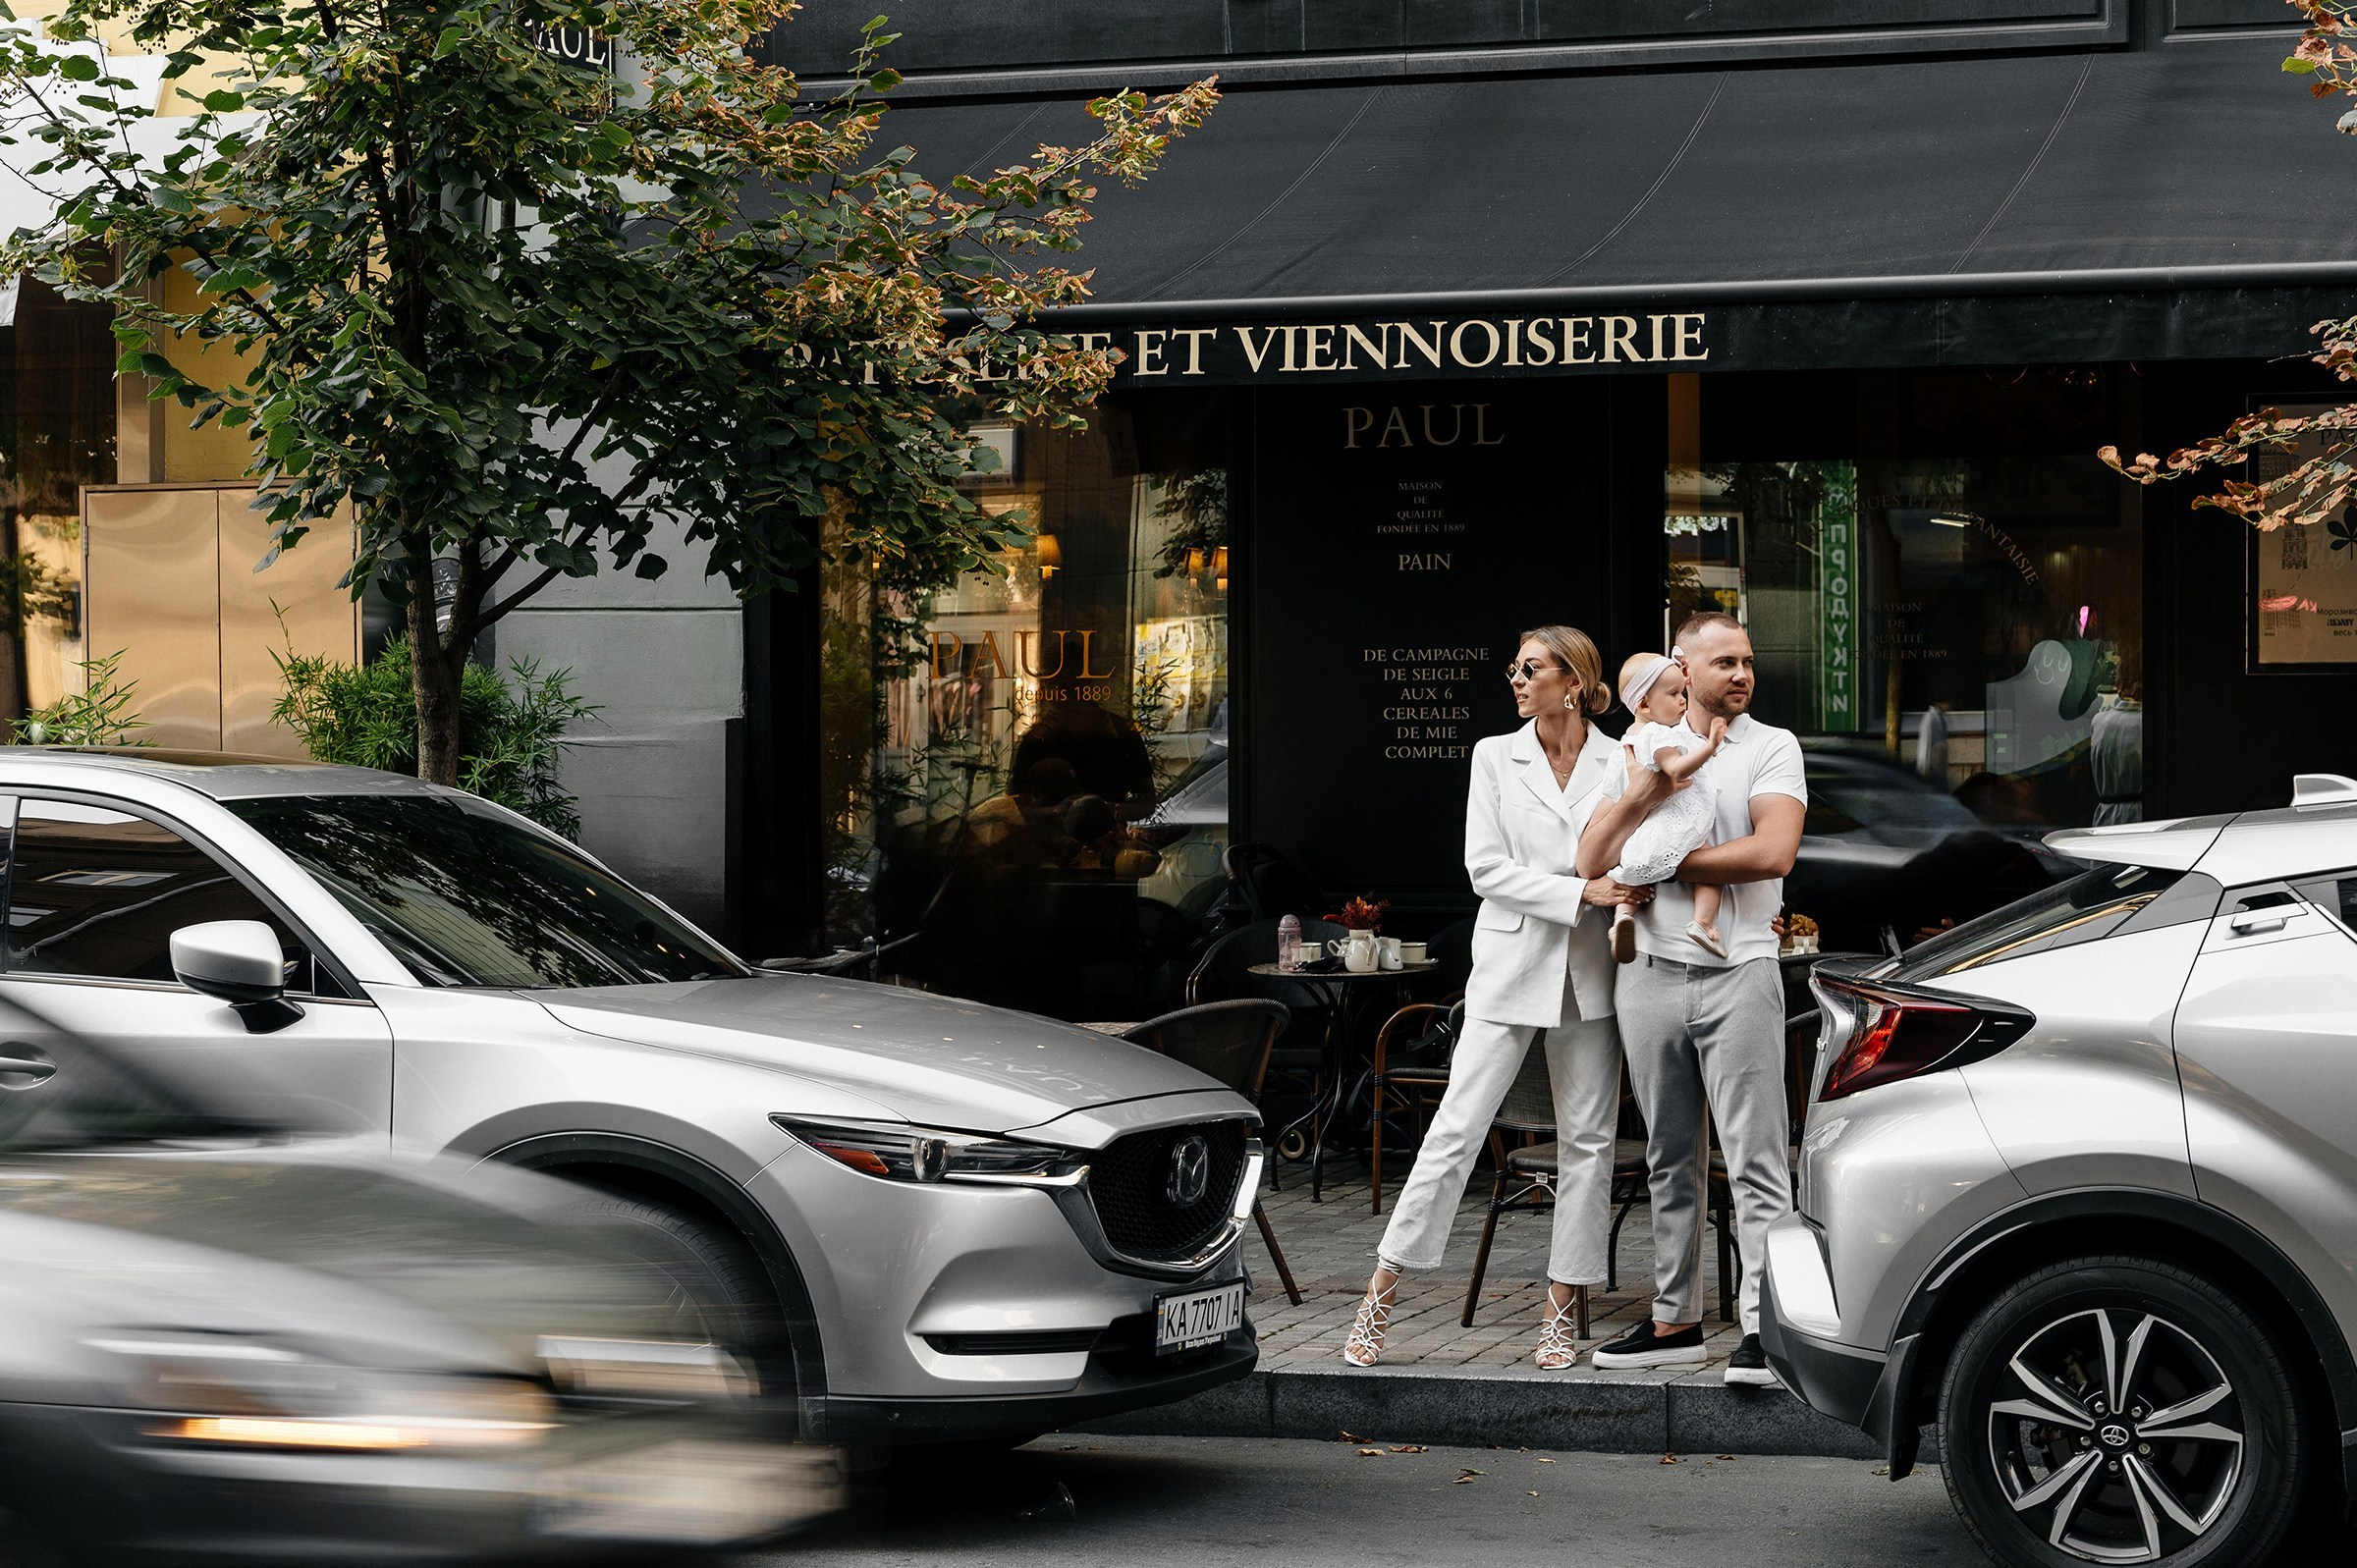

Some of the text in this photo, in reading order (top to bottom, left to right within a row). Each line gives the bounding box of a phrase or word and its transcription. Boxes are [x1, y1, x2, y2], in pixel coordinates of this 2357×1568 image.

[524, 19, 606, 65] AUL
[1133, 327, 1217, 377] ET
[1233, 312, 1710, 374] VIENNOISERIE
[1343, 404, 1505, 449] PAUL
[1398, 481, 1443, 491] MAISON
[1413, 496, 1428, 505] DE
[1398, 507, 1445, 521] QUALITÉ
[1425, 523, 1440, 533] EN
[1444, 523, 1465, 532] 1889
[1966, 511, 2040, 586] FANTAISIE
[1398, 553, 1452, 570] PAIN
[1871, 602, 1922, 613] MAISON
[926, 629, 1116, 679] PAUL
[1364, 648, 1490, 662] DE CAMPAGNE
[1922, 649, 1948, 659] 1889
[1384, 668, 1470, 680] DE SEIGLE
[1015, 685, 1112, 702] depuis 1889
[1400, 687, 1453, 700] AUX 6
[1383, 707, 1470, 720] CEREALES
[1397, 727, 1457, 738] DE MIE
[1385, 746, 1469, 759] COMPLET
[1165, 1290, 1239, 1339] KA 7707 IA
